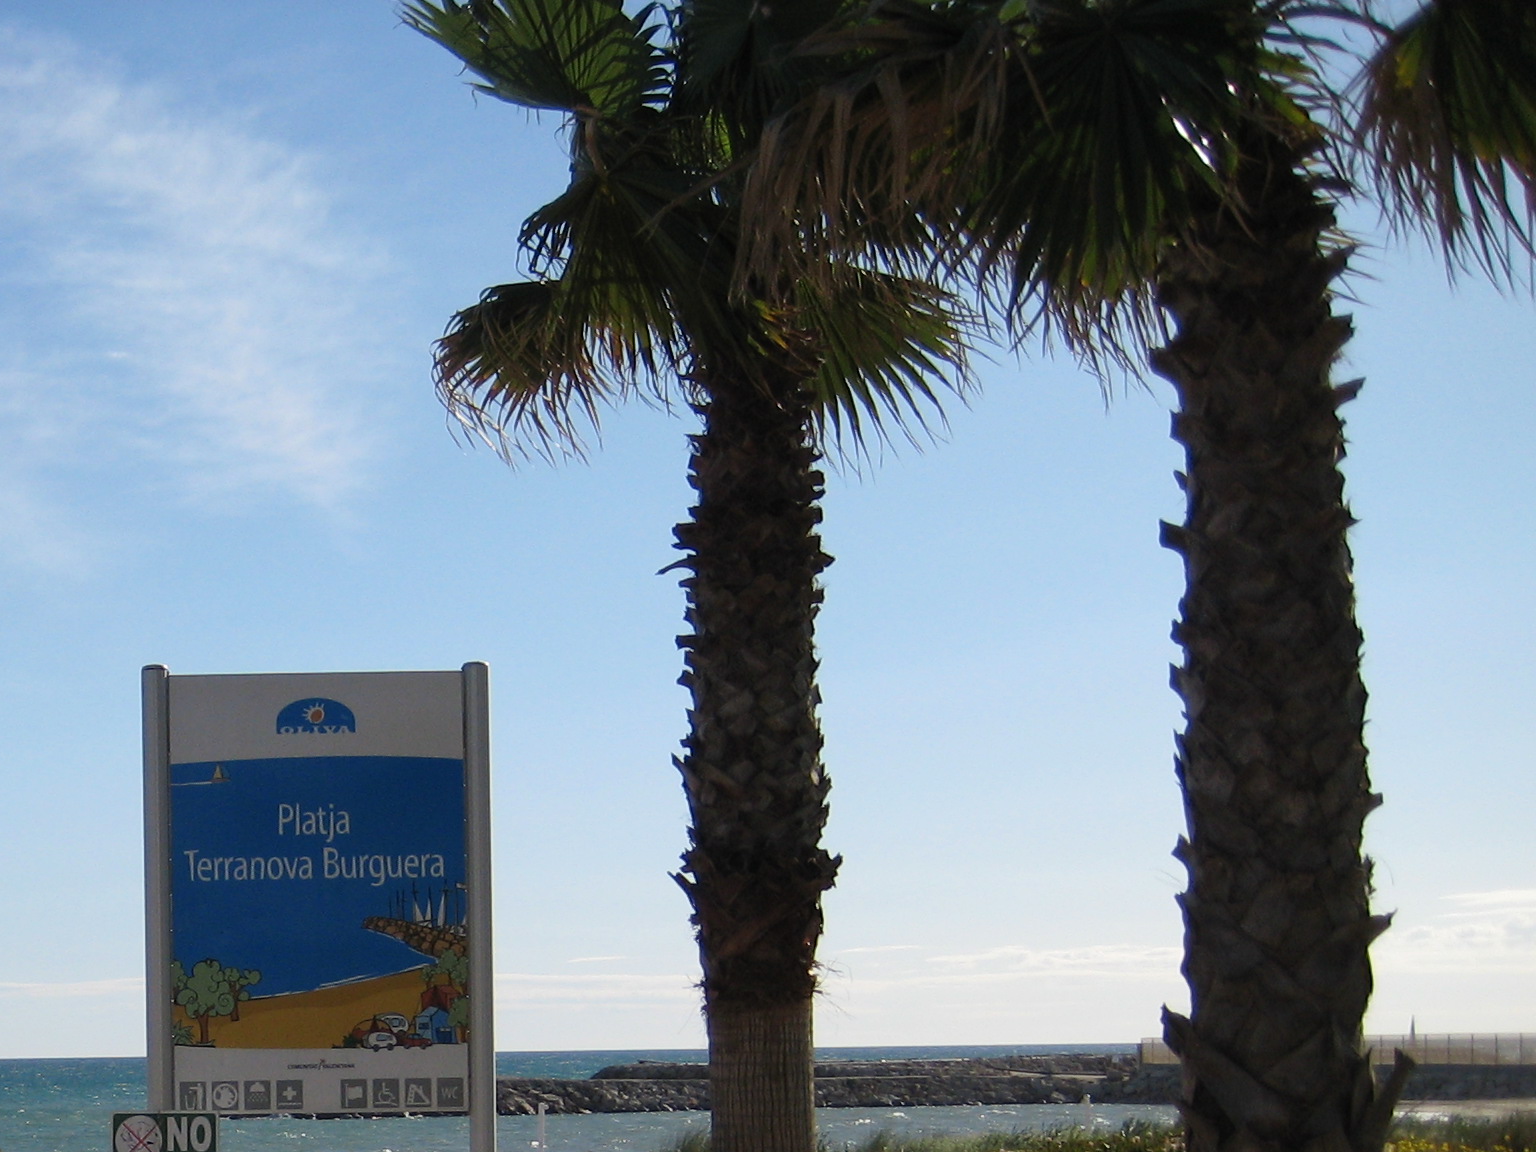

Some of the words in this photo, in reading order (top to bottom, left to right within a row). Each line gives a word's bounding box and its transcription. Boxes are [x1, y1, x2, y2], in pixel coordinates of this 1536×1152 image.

[278, 803, 350, 842] Platja
[183, 849, 313, 881] Terranova
[323, 847, 445, 886] Burguera
[441, 1086, 459, 1099] WC
[166, 1115, 212, 1152] NO
